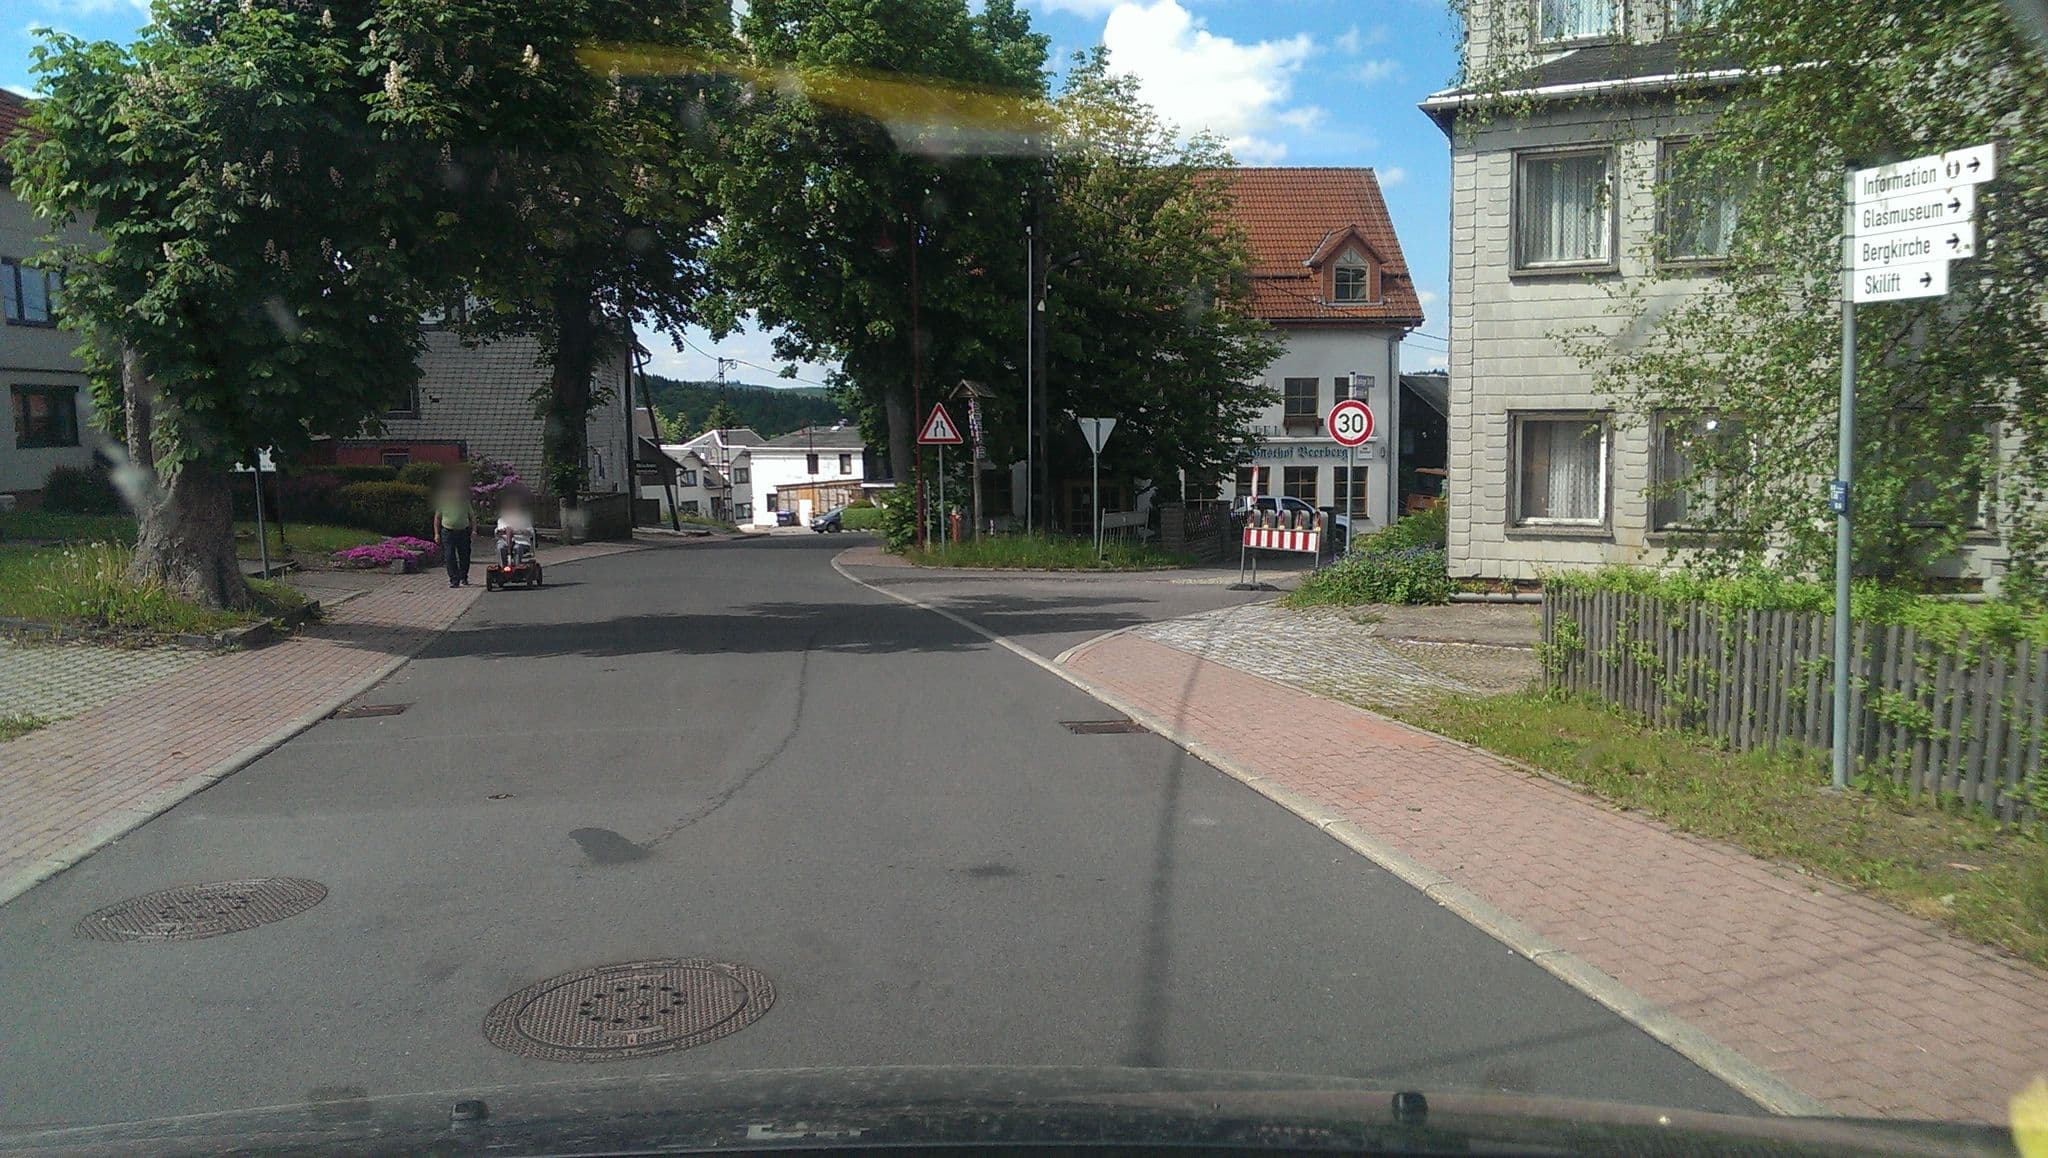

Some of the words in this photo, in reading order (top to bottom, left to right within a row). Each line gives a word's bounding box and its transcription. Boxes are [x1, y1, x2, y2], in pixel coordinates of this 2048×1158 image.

[1863, 166, 1937, 195] Information
[1863, 203, 1943, 228] Glasmuseum
[1862, 236, 1931, 264] Bergkirche
[1864, 272, 1901, 294] Skilift
[1338, 413, 1363, 433] 30
